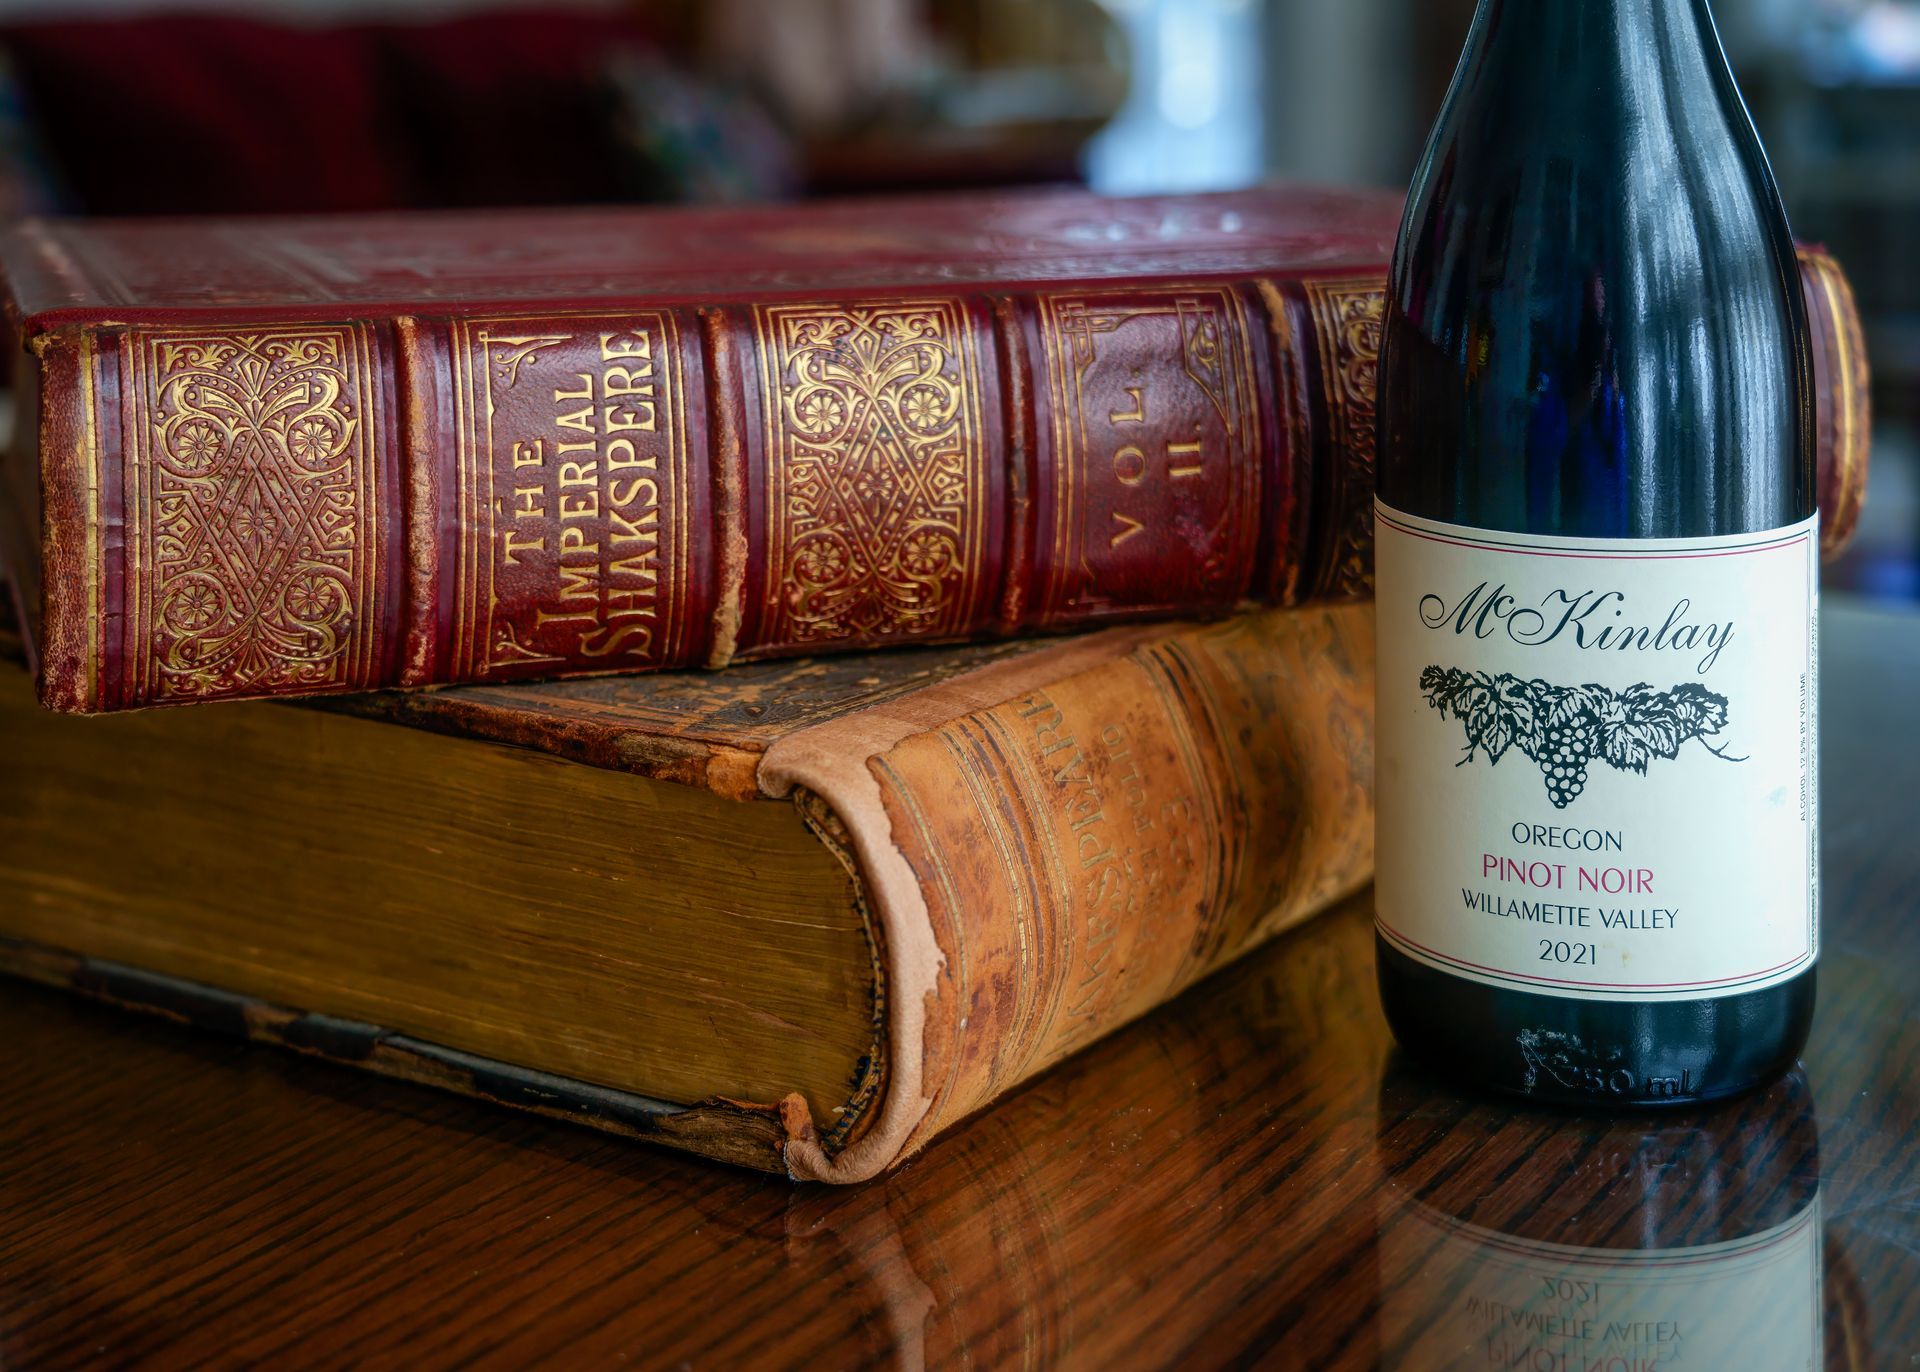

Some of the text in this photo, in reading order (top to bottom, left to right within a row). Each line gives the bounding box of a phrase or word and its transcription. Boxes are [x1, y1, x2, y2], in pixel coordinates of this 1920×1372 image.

[504, 438, 545, 566] THE
[537, 372, 601, 627] IMPERIAL
[579, 330, 660, 659] SHAKSPERE
[1419, 581, 1735, 675] McKinlay
[1799, 721, 1806, 734] BY
[1511, 822, 1622, 852] OREGON
[1013, 689, 1122, 1060] HAKESPEARE
[1482, 853, 1654, 894] PINOT NOIR
[1461, 888, 1679, 930] WILLAMETTE VALLEY
[1538, 938, 1596, 966] 2021
[1647, 1068, 1691, 1096] ml
